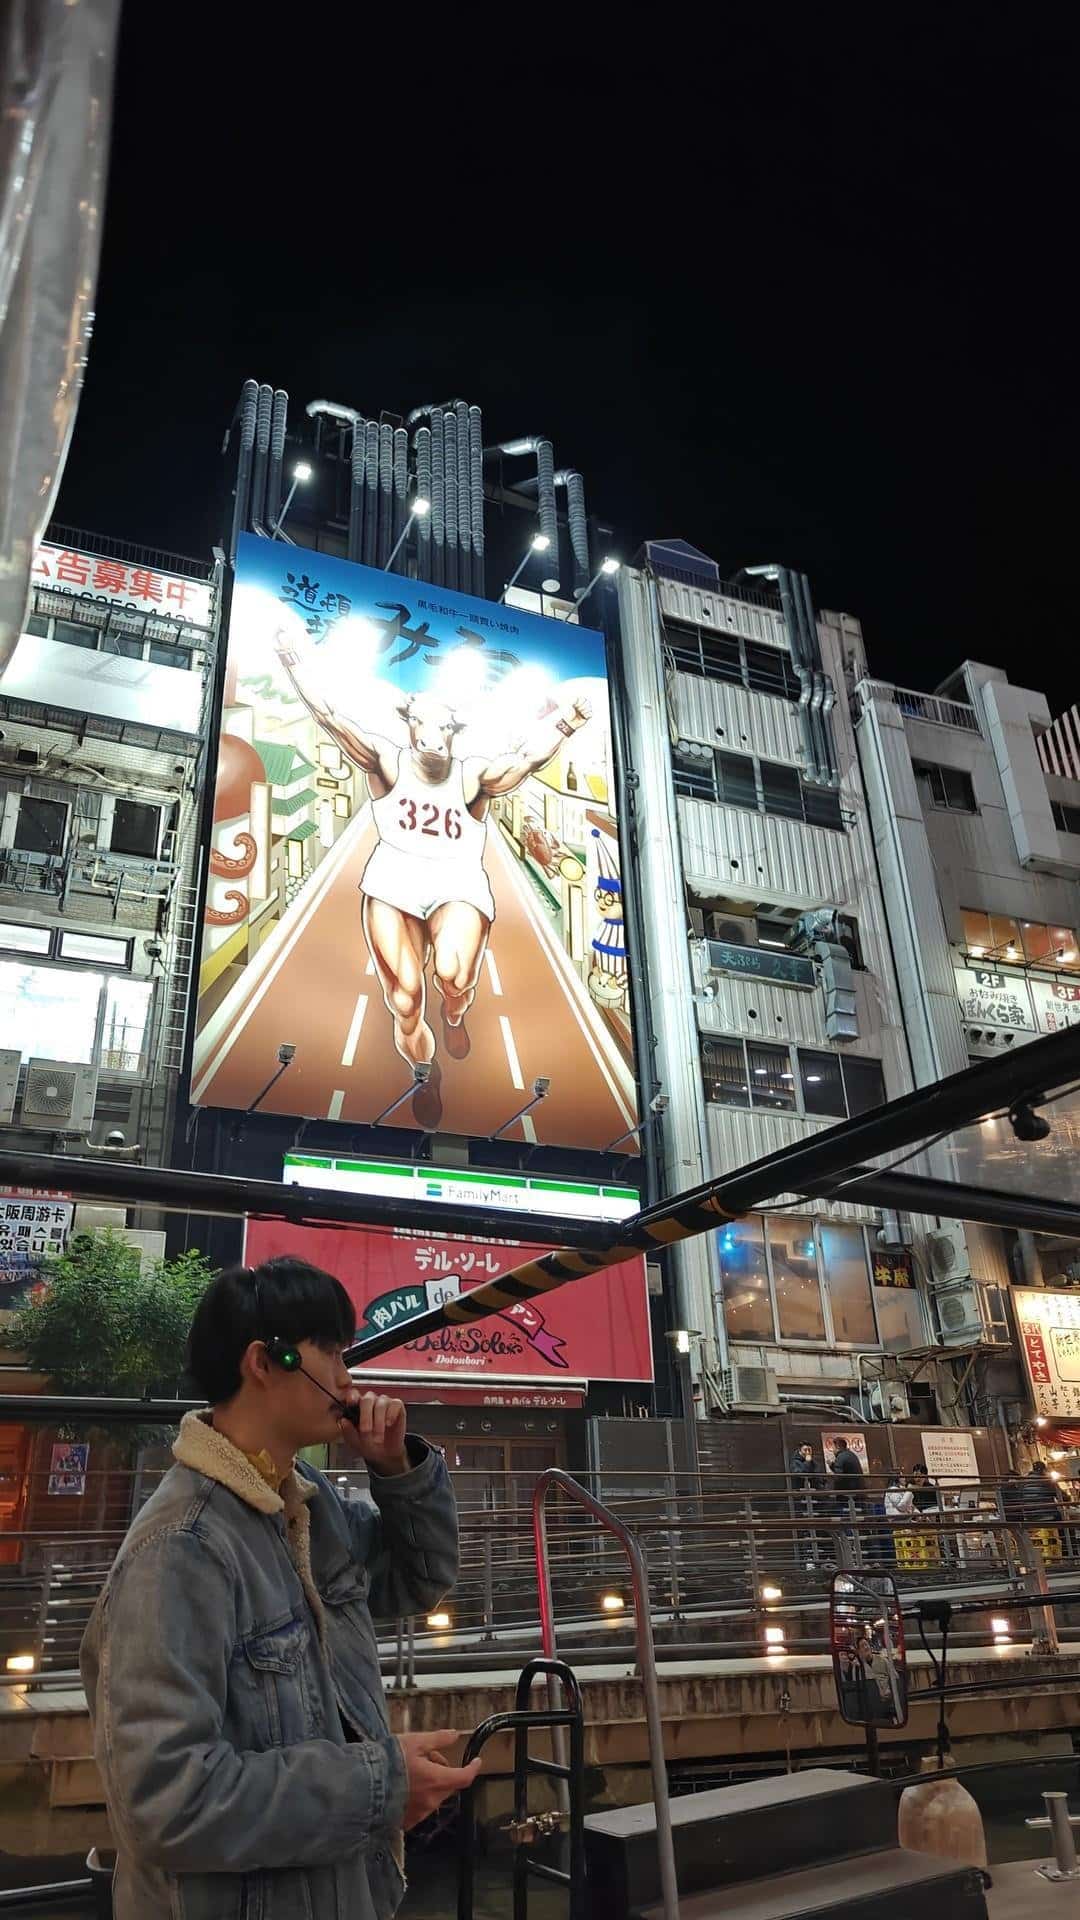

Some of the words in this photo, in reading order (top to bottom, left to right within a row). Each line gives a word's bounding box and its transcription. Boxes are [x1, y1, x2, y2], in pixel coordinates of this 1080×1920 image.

[399, 798, 462, 840] 326
[981, 973, 1000, 987] 2F
[1057, 986, 1075, 1000] 3F
[448, 1185, 519, 1204] FamilyMart
[372, 1294, 422, 1330] 肉バル
[433, 1287, 454, 1304] de
[436, 1354, 487, 1366] Dotonbori
